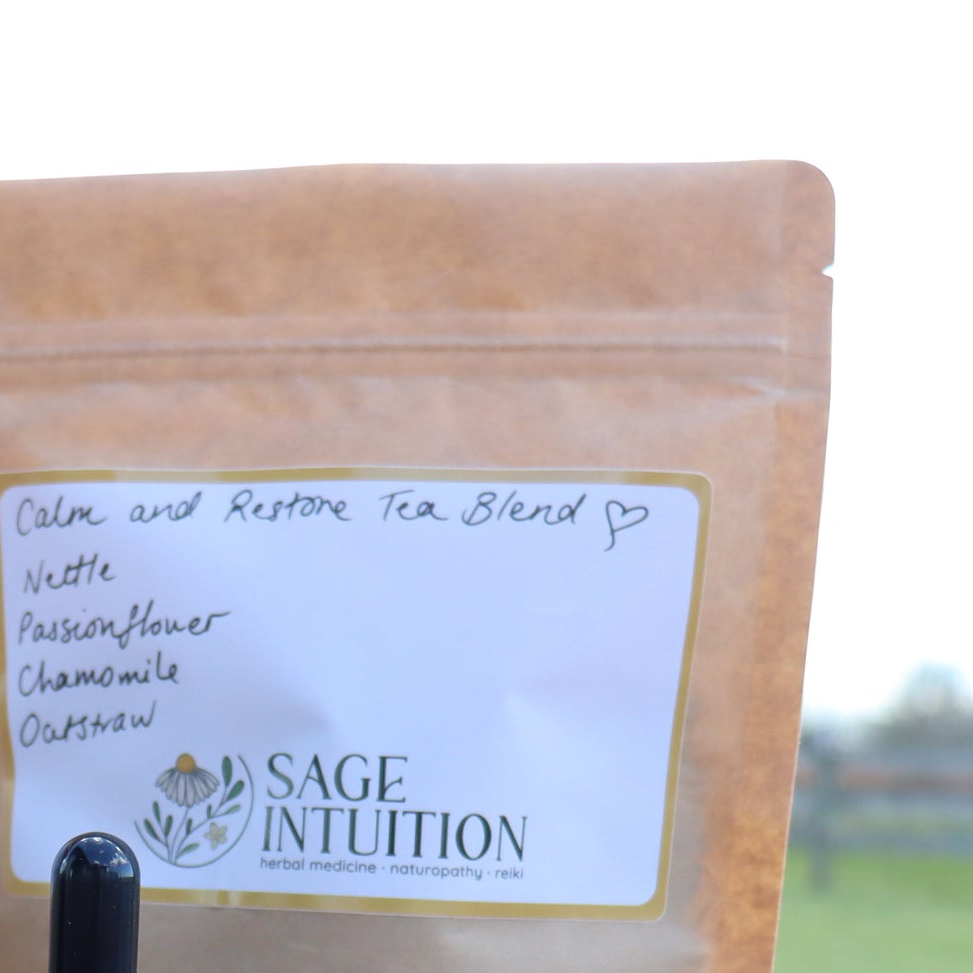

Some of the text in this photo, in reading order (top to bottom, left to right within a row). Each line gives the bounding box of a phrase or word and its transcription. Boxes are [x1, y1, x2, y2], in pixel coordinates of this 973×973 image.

[16, 489, 587, 536] Calm and Restore Tea Blend
[24, 553, 116, 594] Nettle
[19, 599, 230, 650] Passionflower
[20, 652, 180, 698] Chamomile
[267, 752, 408, 803] SAGE
[262, 806, 527, 863] INTUITION
[260, 856, 524, 881] herbal medicine naturopathy reiki
